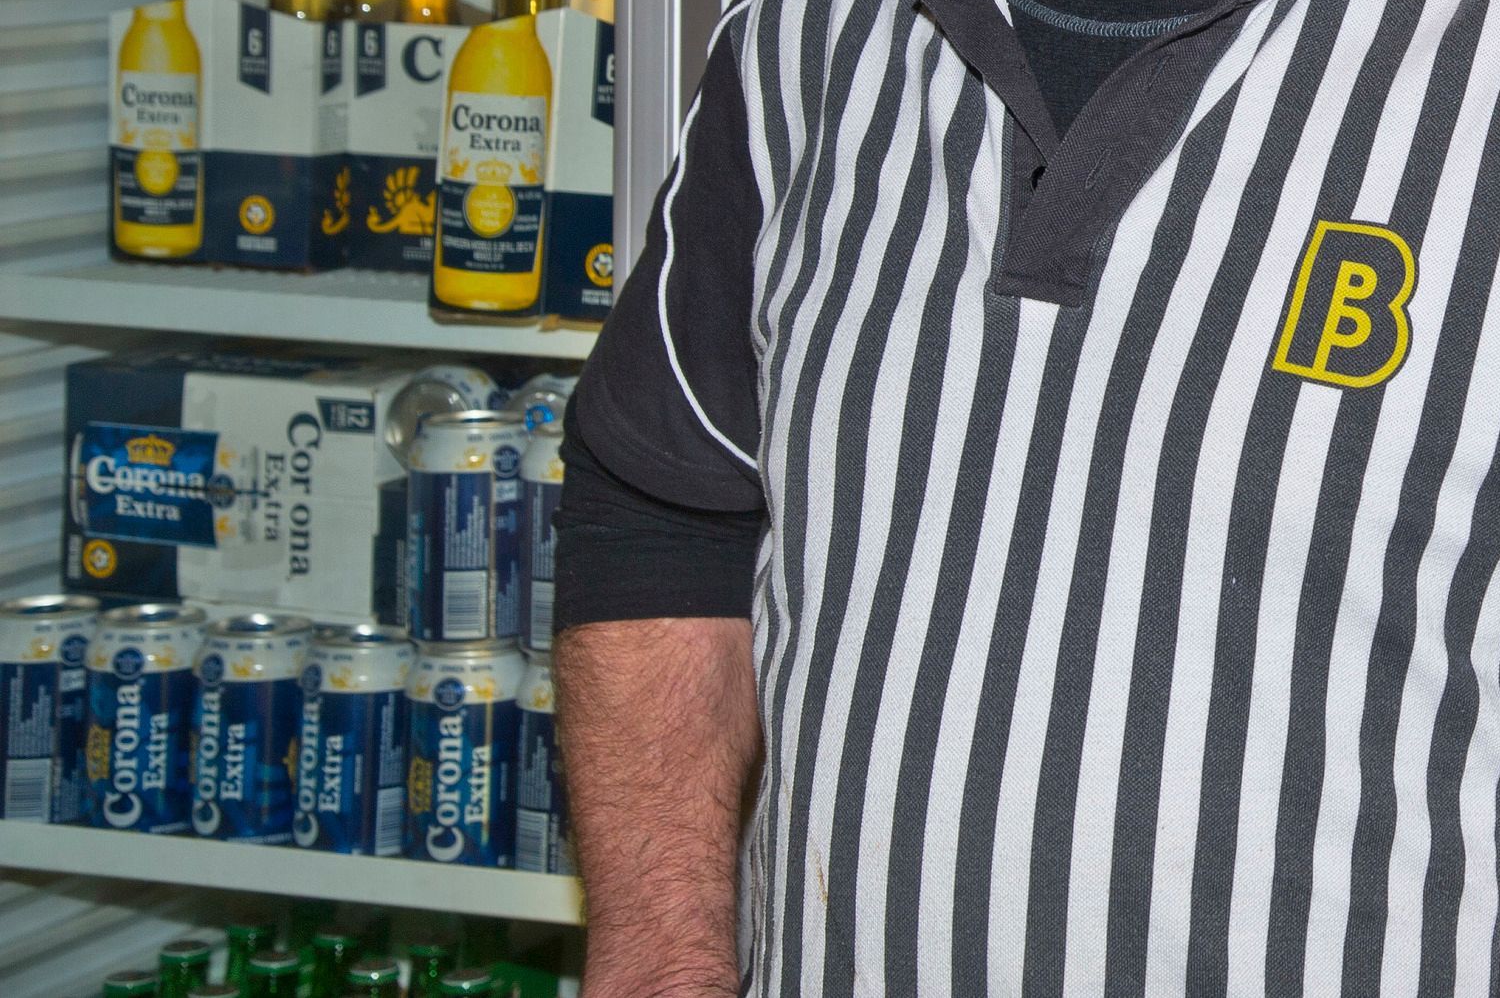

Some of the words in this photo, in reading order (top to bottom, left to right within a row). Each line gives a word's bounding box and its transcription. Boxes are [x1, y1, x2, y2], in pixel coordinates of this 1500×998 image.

[364, 28, 380, 57] 6
[121, 82, 195, 107] Corona
[453, 103, 542, 133] Corona
[469, 133, 522, 153] Extra
[86, 455, 206, 501] Corona
[114, 494, 181, 521] Extra
[263, 452, 286, 543] Extra
[286, 411, 322, 578] Corona
[103, 683, 144, 828] Corona
[142, 712, 169, 791] Extra
[191, 689, 222, 836] Corona
[220, 722, 246, 802] Extra
[318, 734, 344, 814] Extra
[426, 714, 465, 862] Corona
[464, 745, 490, 825] Extra
